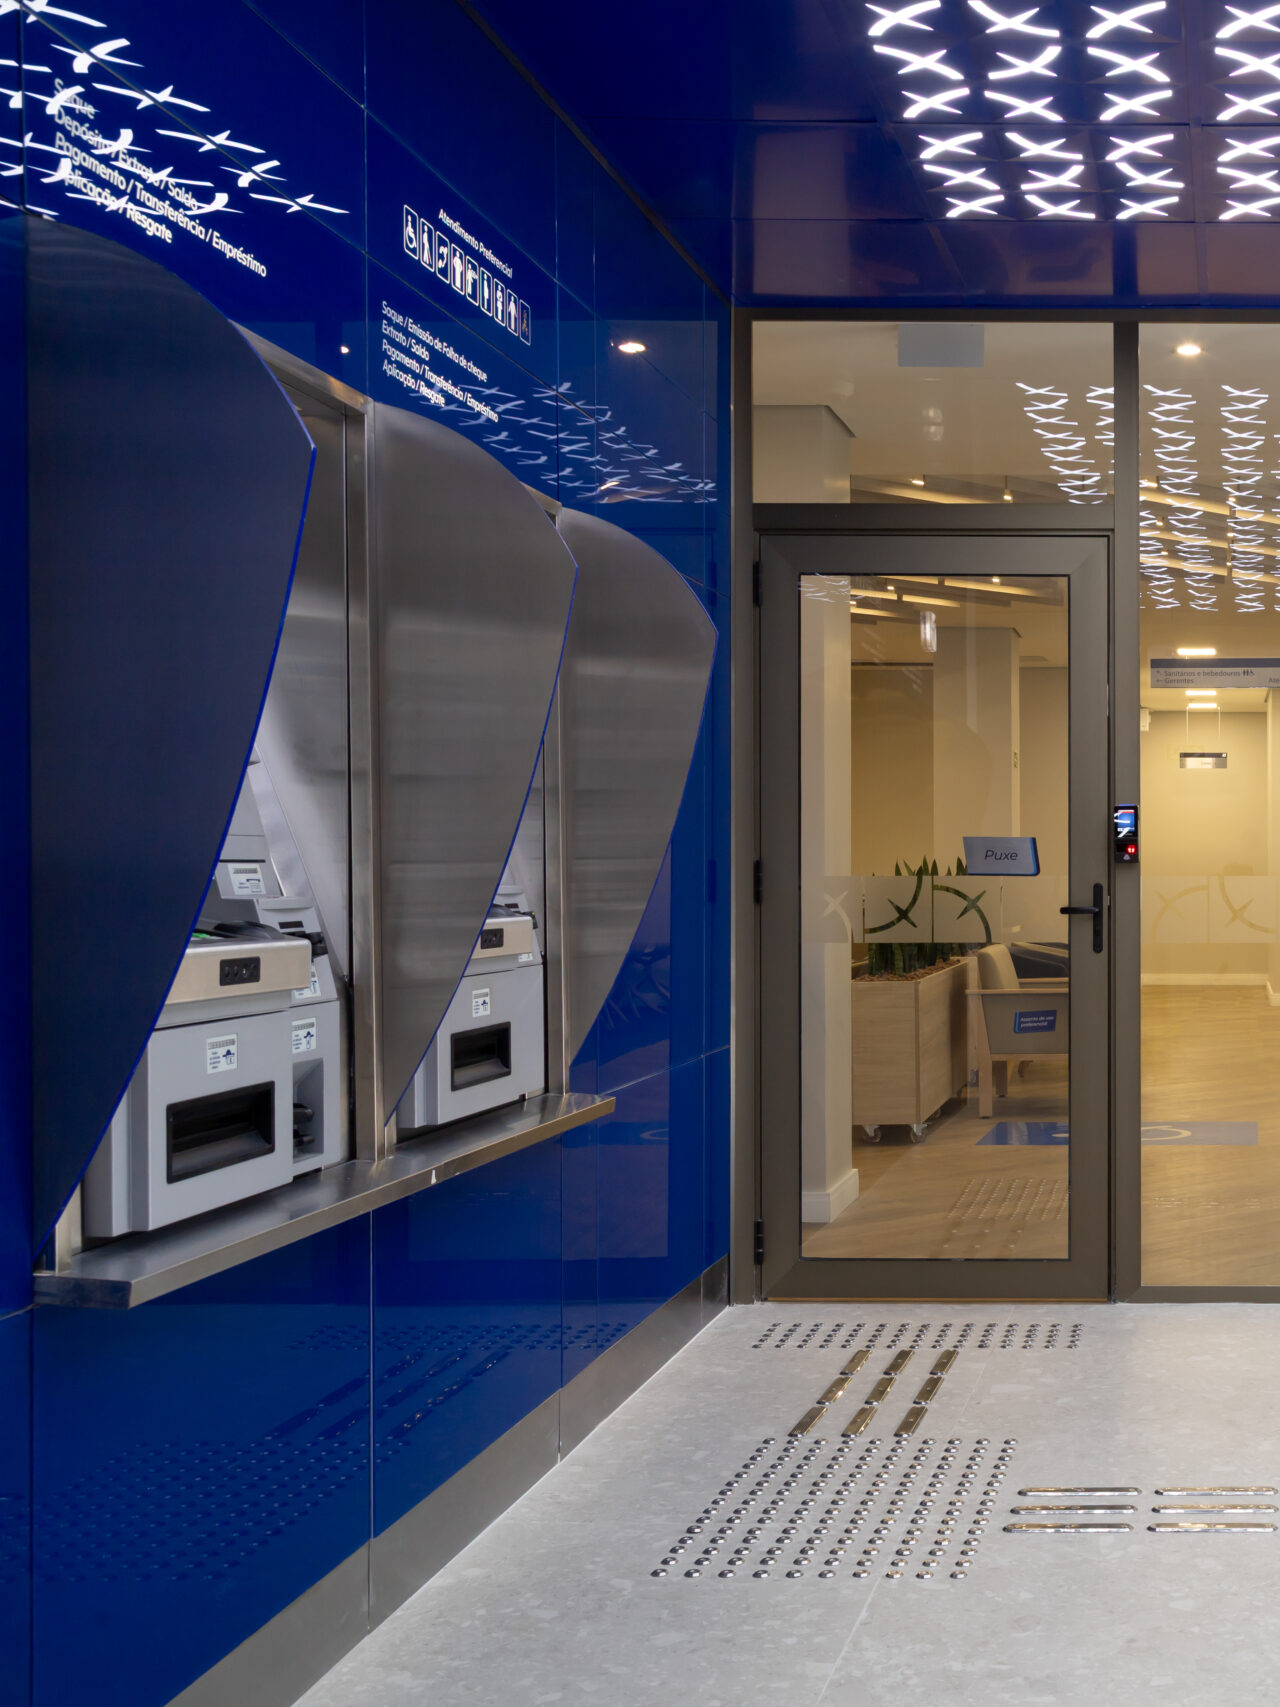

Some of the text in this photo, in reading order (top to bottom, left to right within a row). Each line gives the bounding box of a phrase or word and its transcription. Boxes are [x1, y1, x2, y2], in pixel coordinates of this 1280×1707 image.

[54, 77, 96, 120] Sque
[55, 131, 127, 190] Pagamento
[135, 180, 206, 240] Transferência
[212, 230, 267, 278] Empréstimo
[61, 166, 172, 243] plicaçã Resgate
[167, 180, 198, 211] Saldo
[438, 208, 513, 279] Atendimento Preferencial
[382, 319, 407, 346] Extrato
[411, 338, 430, 361] Saldo
[382, 300, 404, 326] Saque
[408, 318, 434, 346] Emissão
[434, 337, 442, 352] de
[443, 342, 460, 364] Folha
[459, 355, 467, 369] de
[467, 361, 488, 383] cheque
[382, 338, 420, 374] Pagamento
[424, 365, 463, 402] Transferência
[466, 394, 499, 423] Empréstimo
[382, 358, 416, 389] Aplicação
[420, 380, 445, 408] Resgate
[984, 849, 1018, 861] Puxe
